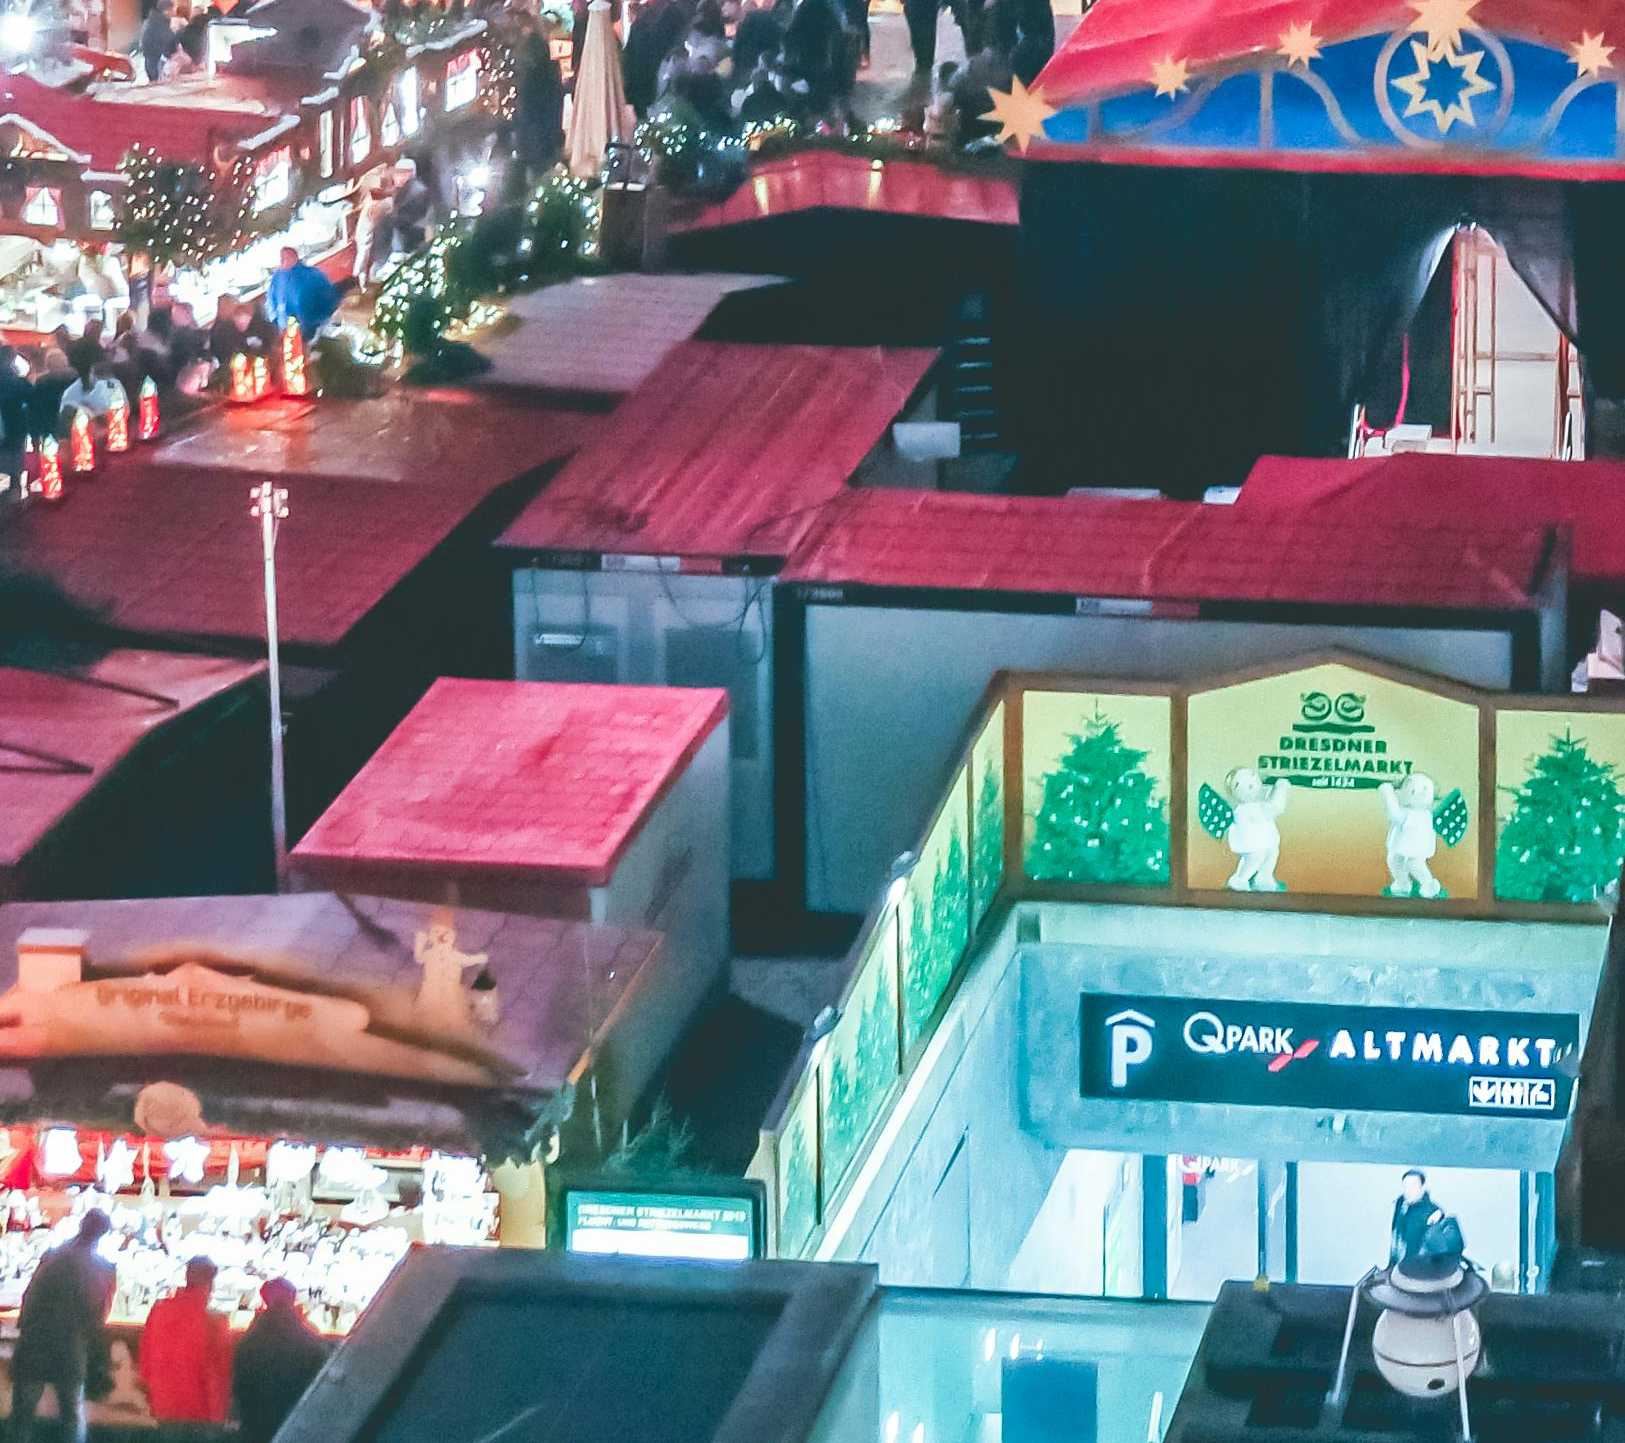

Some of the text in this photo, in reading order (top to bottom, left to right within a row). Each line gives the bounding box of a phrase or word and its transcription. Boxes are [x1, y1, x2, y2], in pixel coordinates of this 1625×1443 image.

[1279, 736, 1387, 754] DRESDNER
[1258, 755, 1413, 775] STRIEZELMARKT
[1111, 1024, 1153, 1088] P
[1329, 1029, 1556, 1067] ALTMARKT
